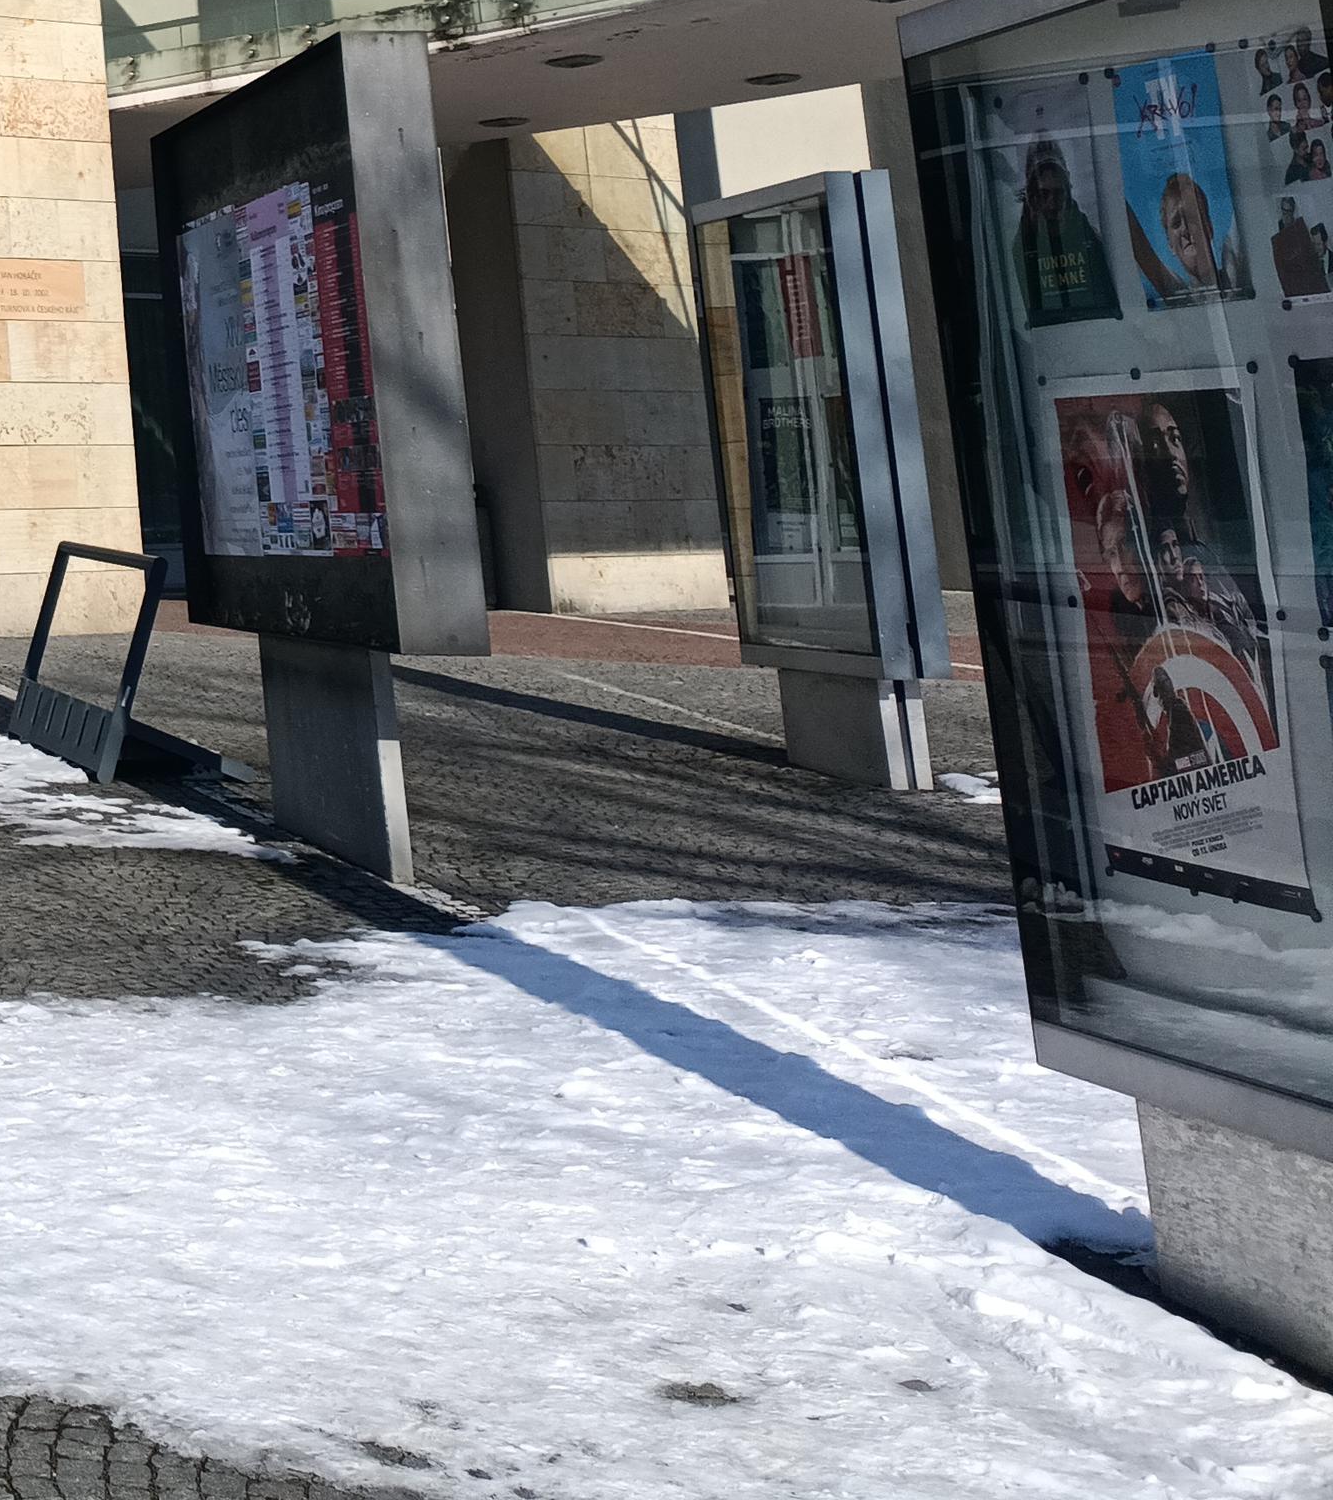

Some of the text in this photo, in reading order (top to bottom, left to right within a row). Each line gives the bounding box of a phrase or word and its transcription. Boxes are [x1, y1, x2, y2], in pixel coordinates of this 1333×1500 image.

[1037, 251, 1086, 270] TUNDRA
[1040, 274, 1055, 289] VE
[767, 405, 804, 418] MALINA
[1131, 754, 1266, 810] CAPTAIN AMERICA
[1173, 790, 1228, 821] NOVÝ SVĚT
